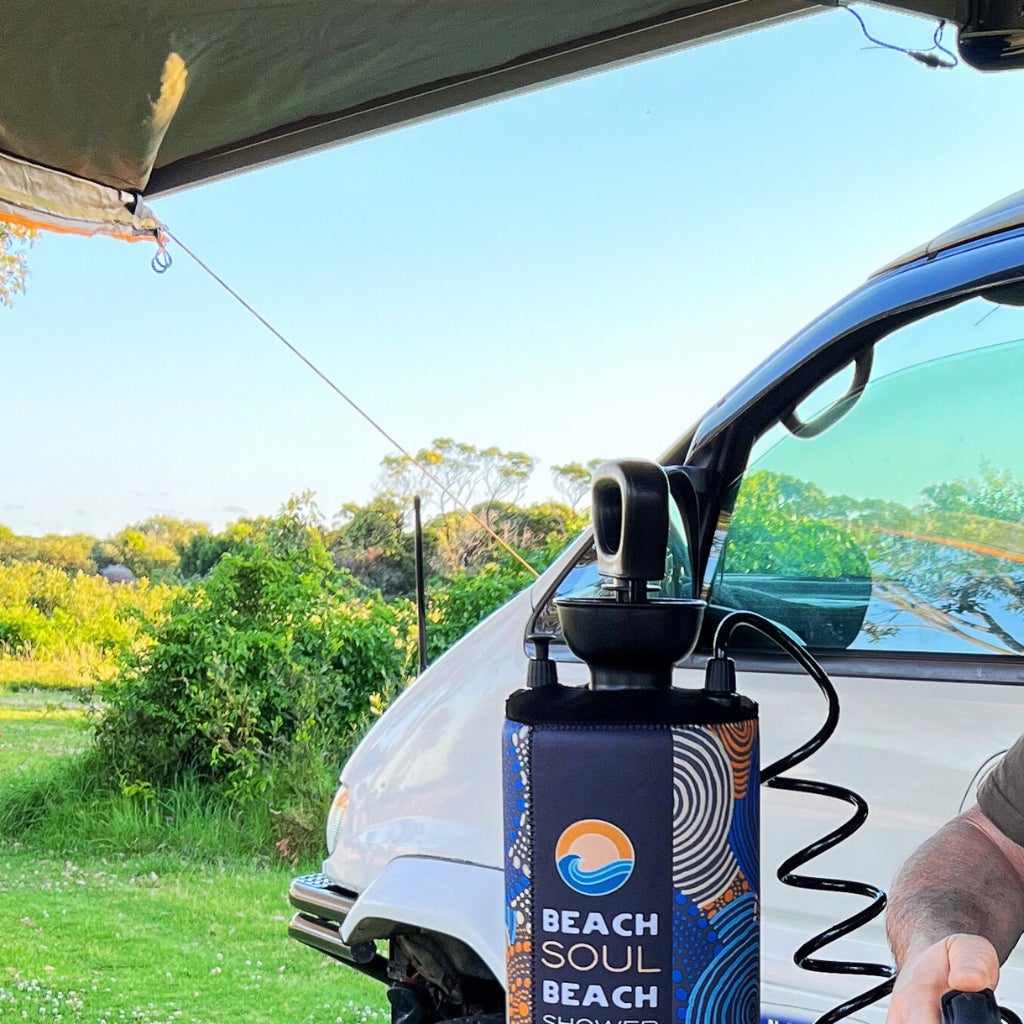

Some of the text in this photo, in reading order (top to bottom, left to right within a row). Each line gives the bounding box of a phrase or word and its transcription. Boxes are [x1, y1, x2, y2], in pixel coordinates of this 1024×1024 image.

[542, 908, 659, 937] BEACH
[541, 940, 662, 973] SOUL
[542, 979, 659, 1009] BEACH
